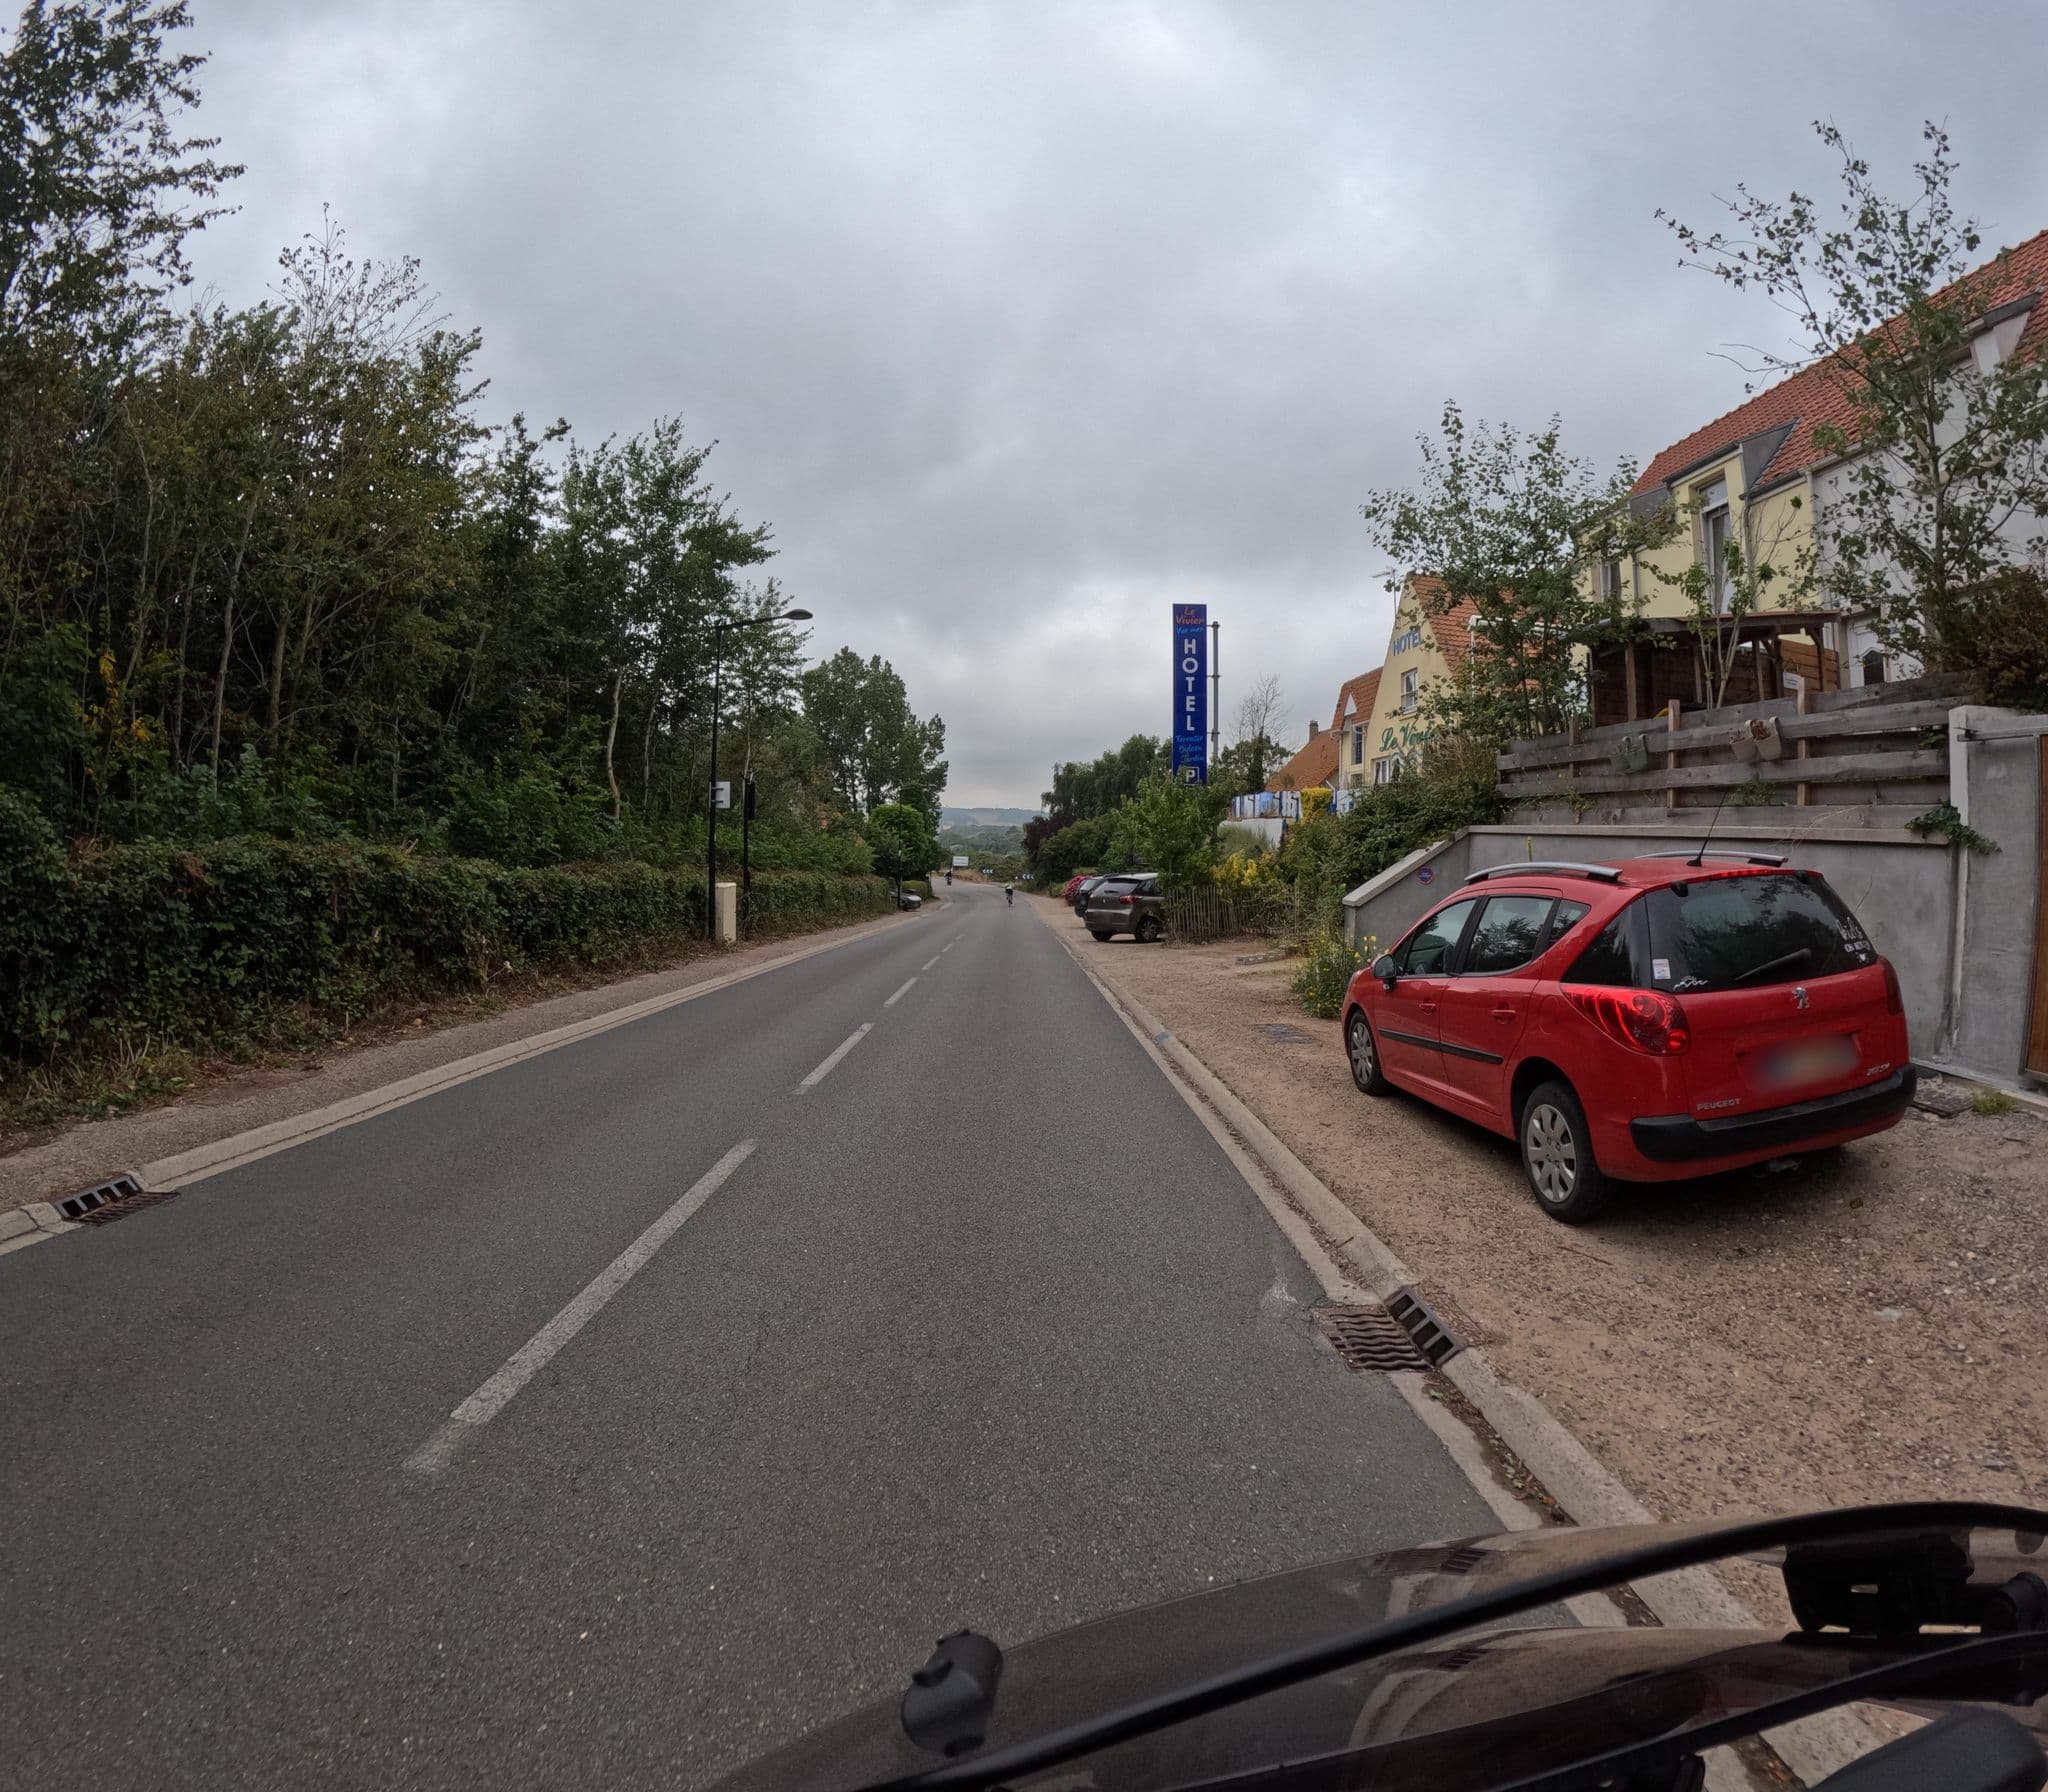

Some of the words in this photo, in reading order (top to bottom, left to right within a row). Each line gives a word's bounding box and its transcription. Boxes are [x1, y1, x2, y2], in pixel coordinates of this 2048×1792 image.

[1394, 626, 1425, 656] HOTEL
[1182, 638, 1199, 732] HOTEL
[1379, 727, 1398, 752] Le
[1697, 1098, 1741, 1111] PEUGEOT
